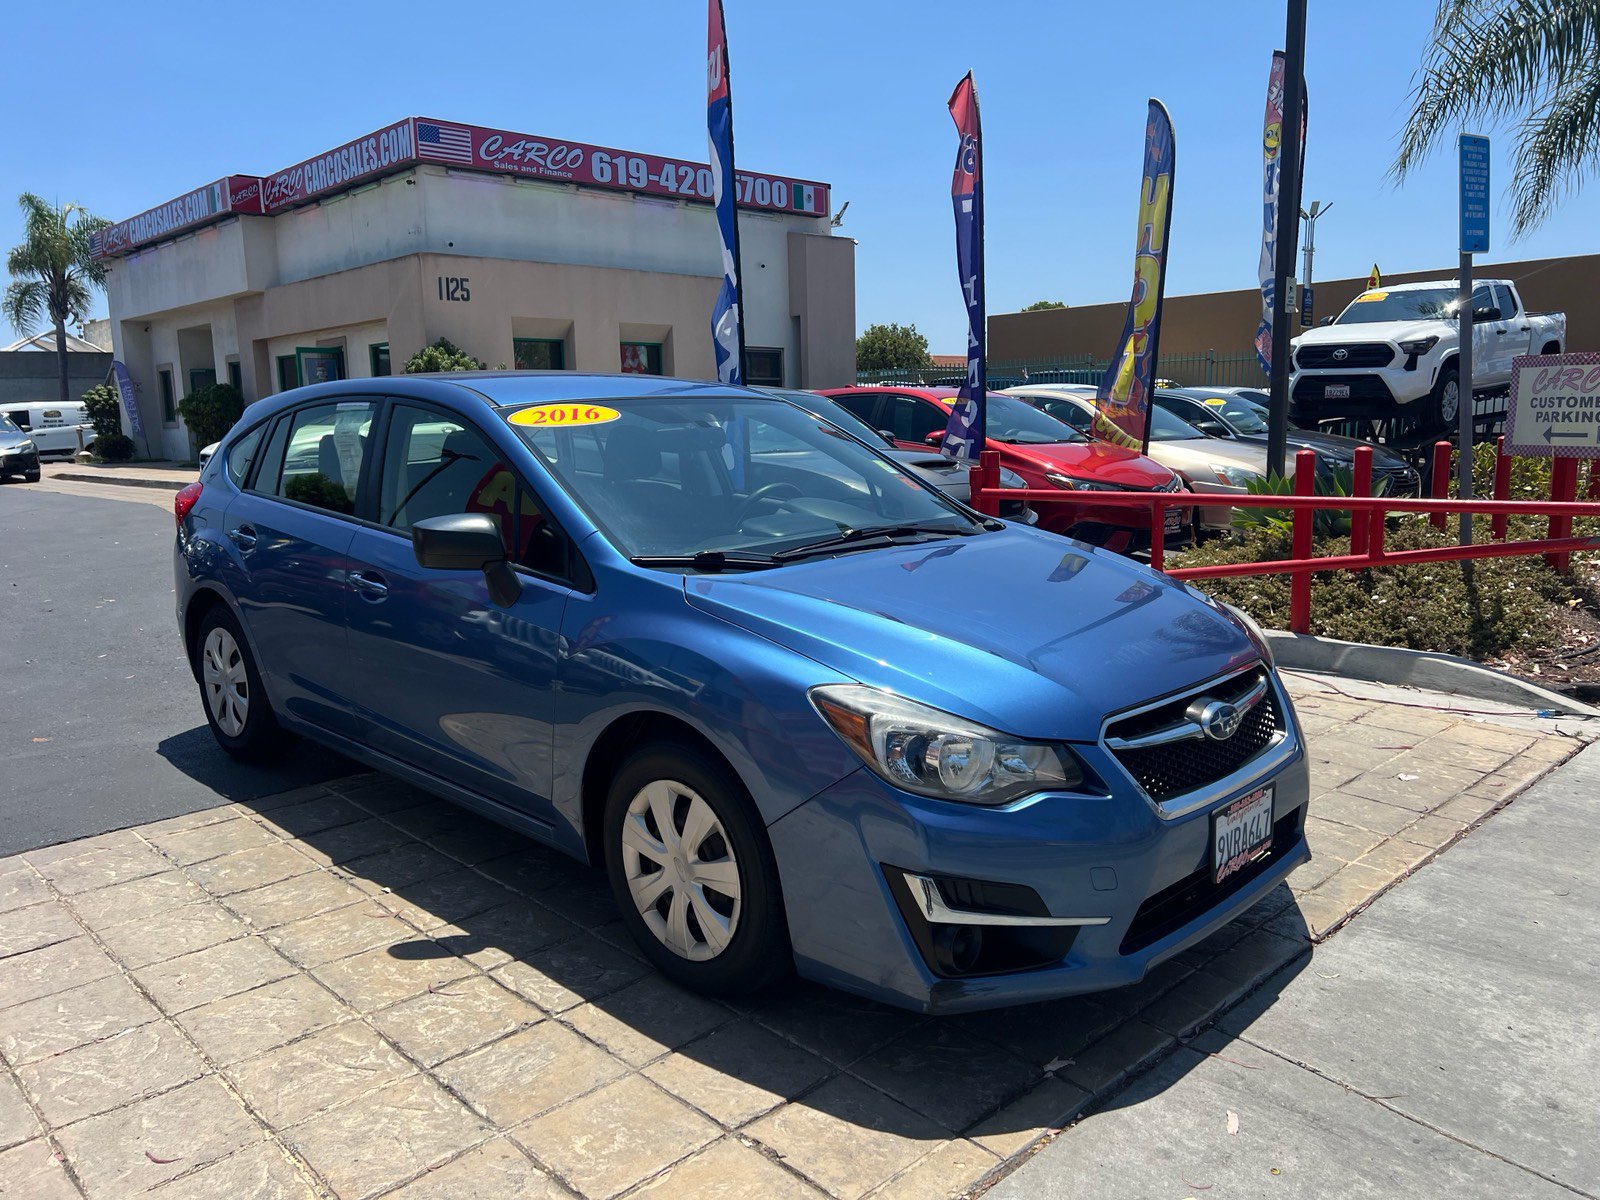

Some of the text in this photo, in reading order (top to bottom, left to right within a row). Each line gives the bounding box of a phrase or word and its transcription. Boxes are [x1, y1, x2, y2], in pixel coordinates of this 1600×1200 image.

[303, 123, 412, 195] CARCOSALES.COM
[478, 135, 788, 209] CARCO 619-420700
[493, 160, 573, 179] Sales and Finance
[230, 183, 259, 205] CARCO
[263, 168, 303, 205] CARCO
[129, 189, 210, 244] CARCOSALES.COM
[438, 276, 471, 302] 1125
[1531, 366, 1600, 395] CARC
[532, 407, 600, 424] 2016
[1529, 396, 1600, 409] CUSTOME
[1217, 807, 1271, 866] 9VRA647
